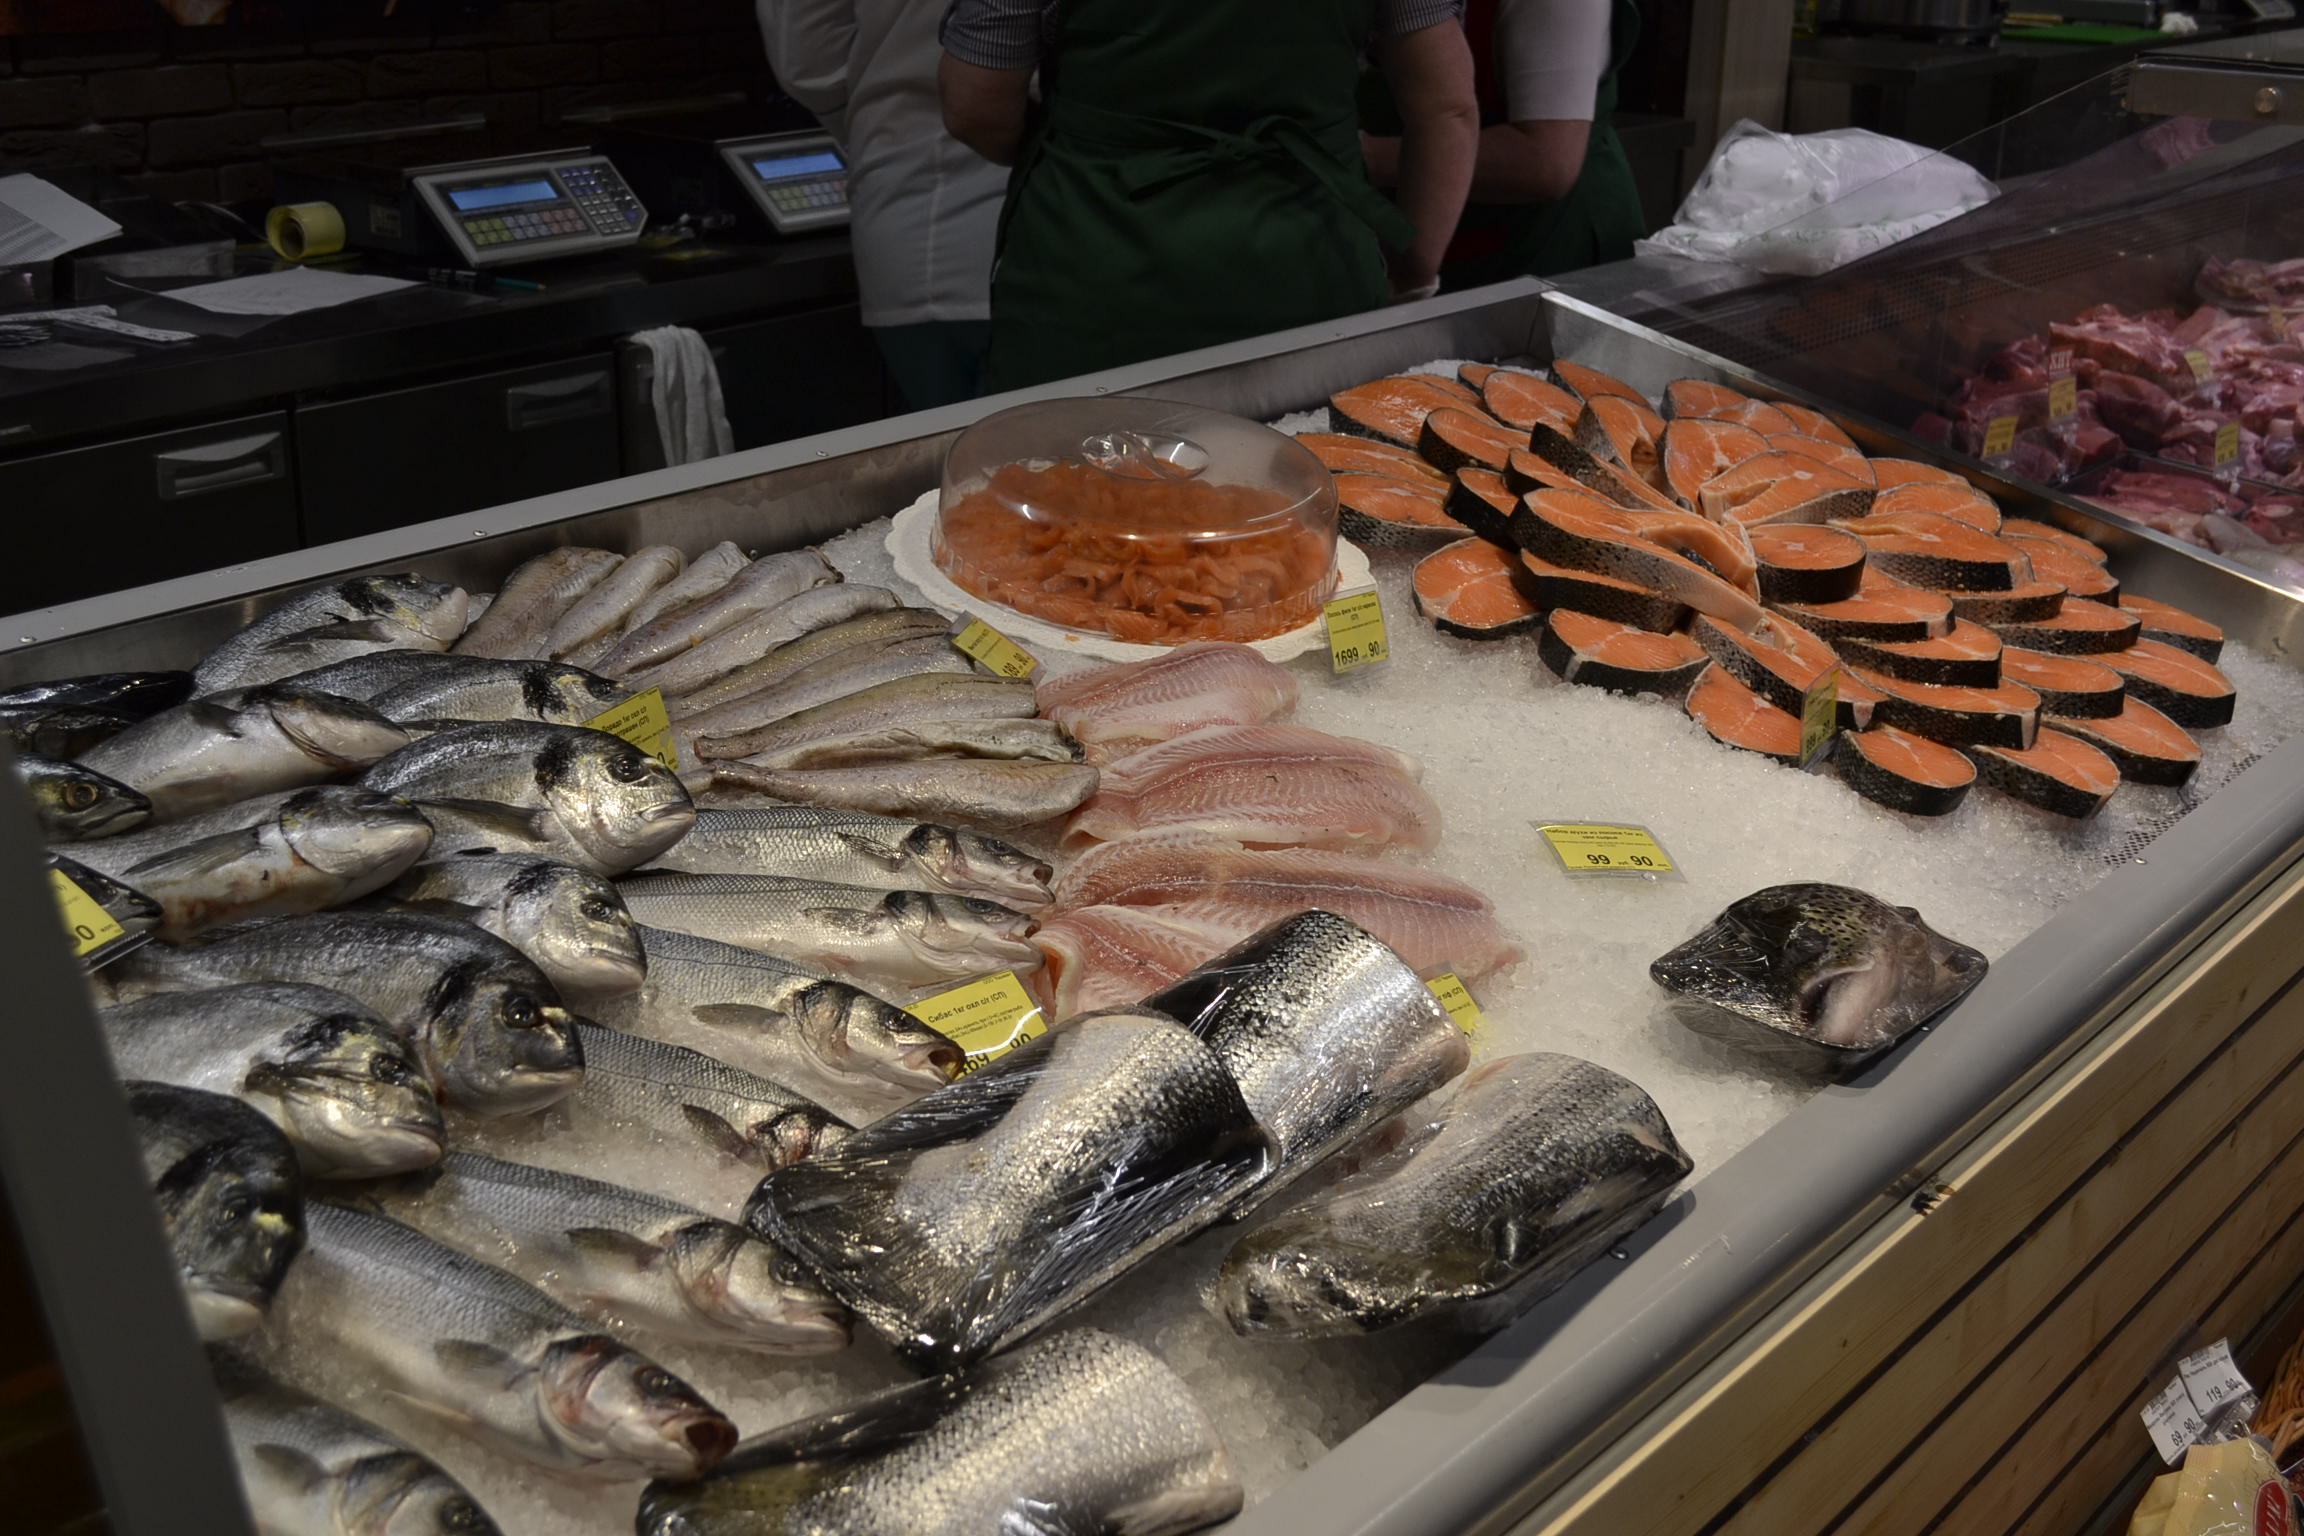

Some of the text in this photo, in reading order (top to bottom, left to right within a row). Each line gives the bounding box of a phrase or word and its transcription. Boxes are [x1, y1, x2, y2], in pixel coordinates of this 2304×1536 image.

[1335, 640, 1379, 666] 1699 90
[1587, 854, 1611, 865] 99
[1630, 855, 1653, 867] 90
[928, 1009, 953, 1023] Сибас
[990, 990, 1008, 1004] (СП)
[2206, 1385, 2222, 1403] 119
[2171, 1430, 2182, 1446] 69
[2183, 1418, 2195, 1434] 90
